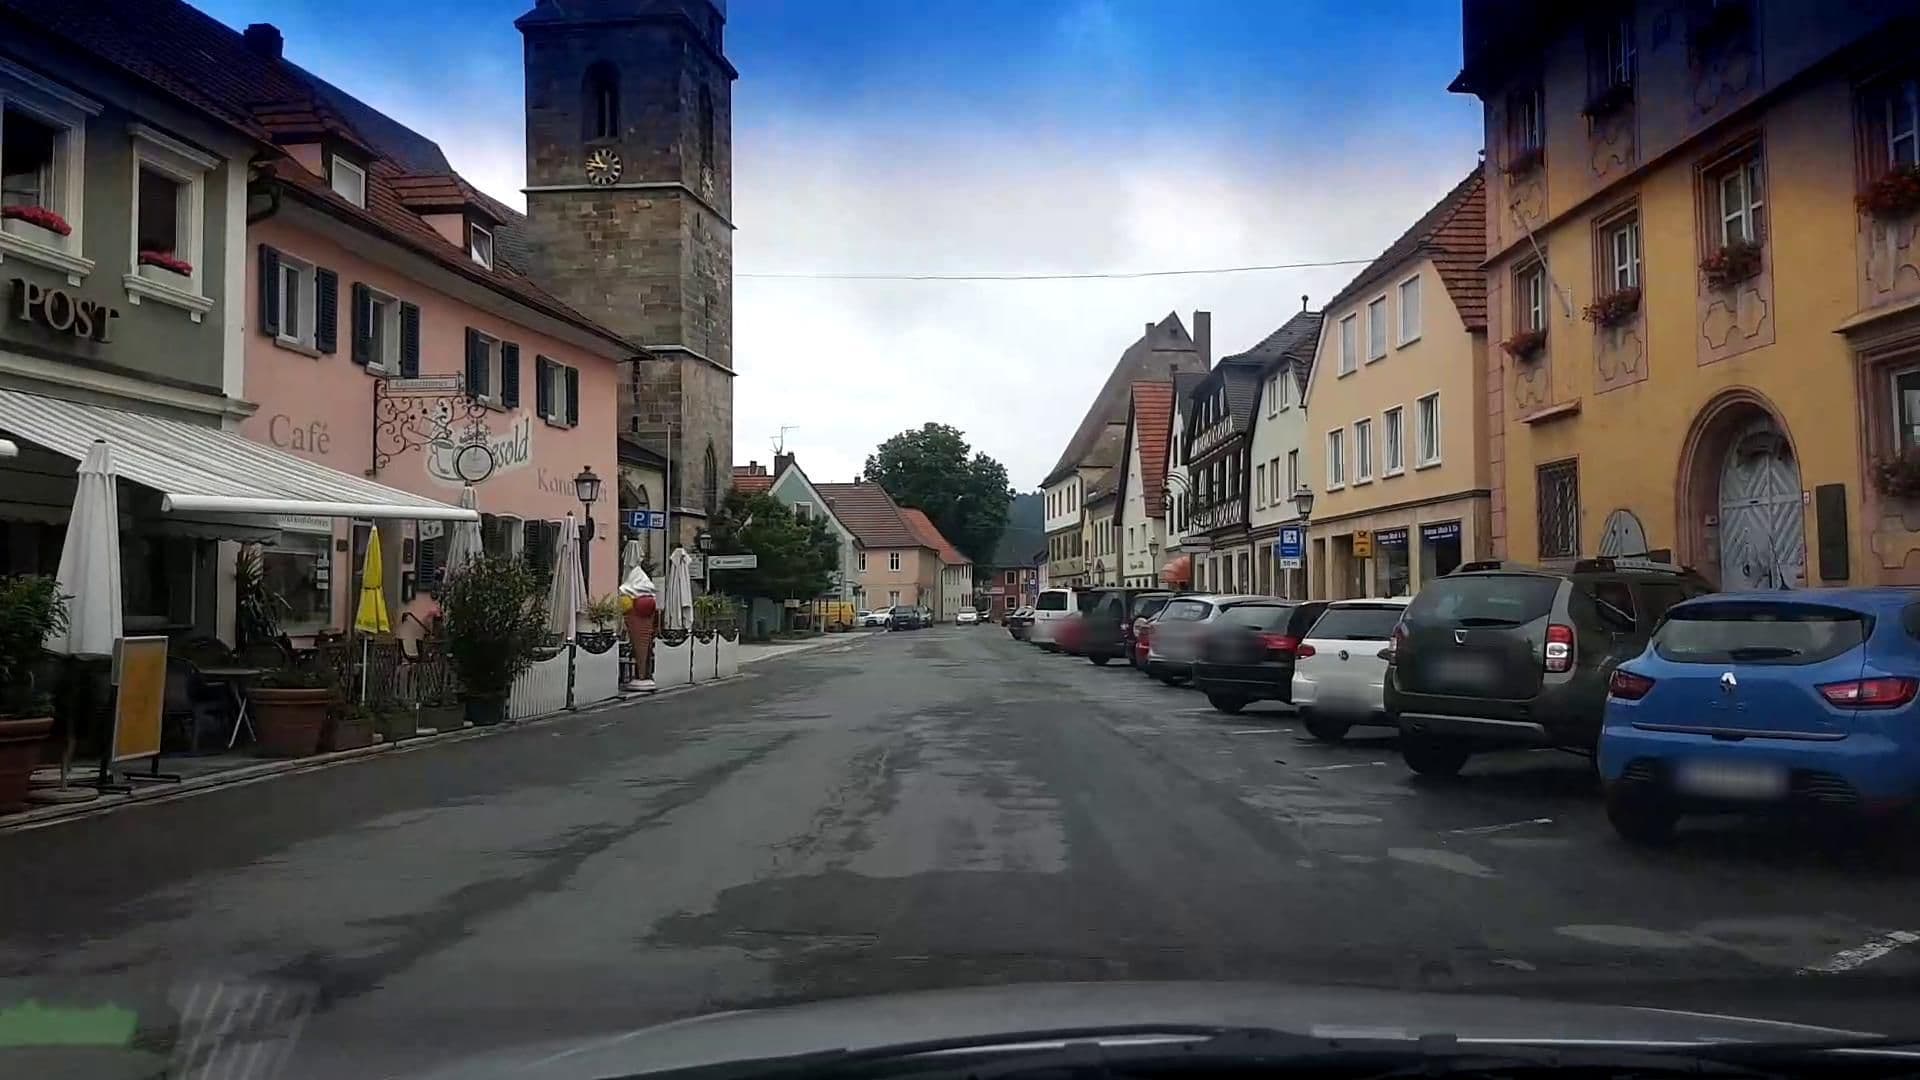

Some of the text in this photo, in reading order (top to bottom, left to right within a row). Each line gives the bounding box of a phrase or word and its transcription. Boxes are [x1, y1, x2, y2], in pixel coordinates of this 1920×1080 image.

[10, 278, 120, 343] POST
[269, 413, 330, 455] Café
[633, 511, 646, 527] P
